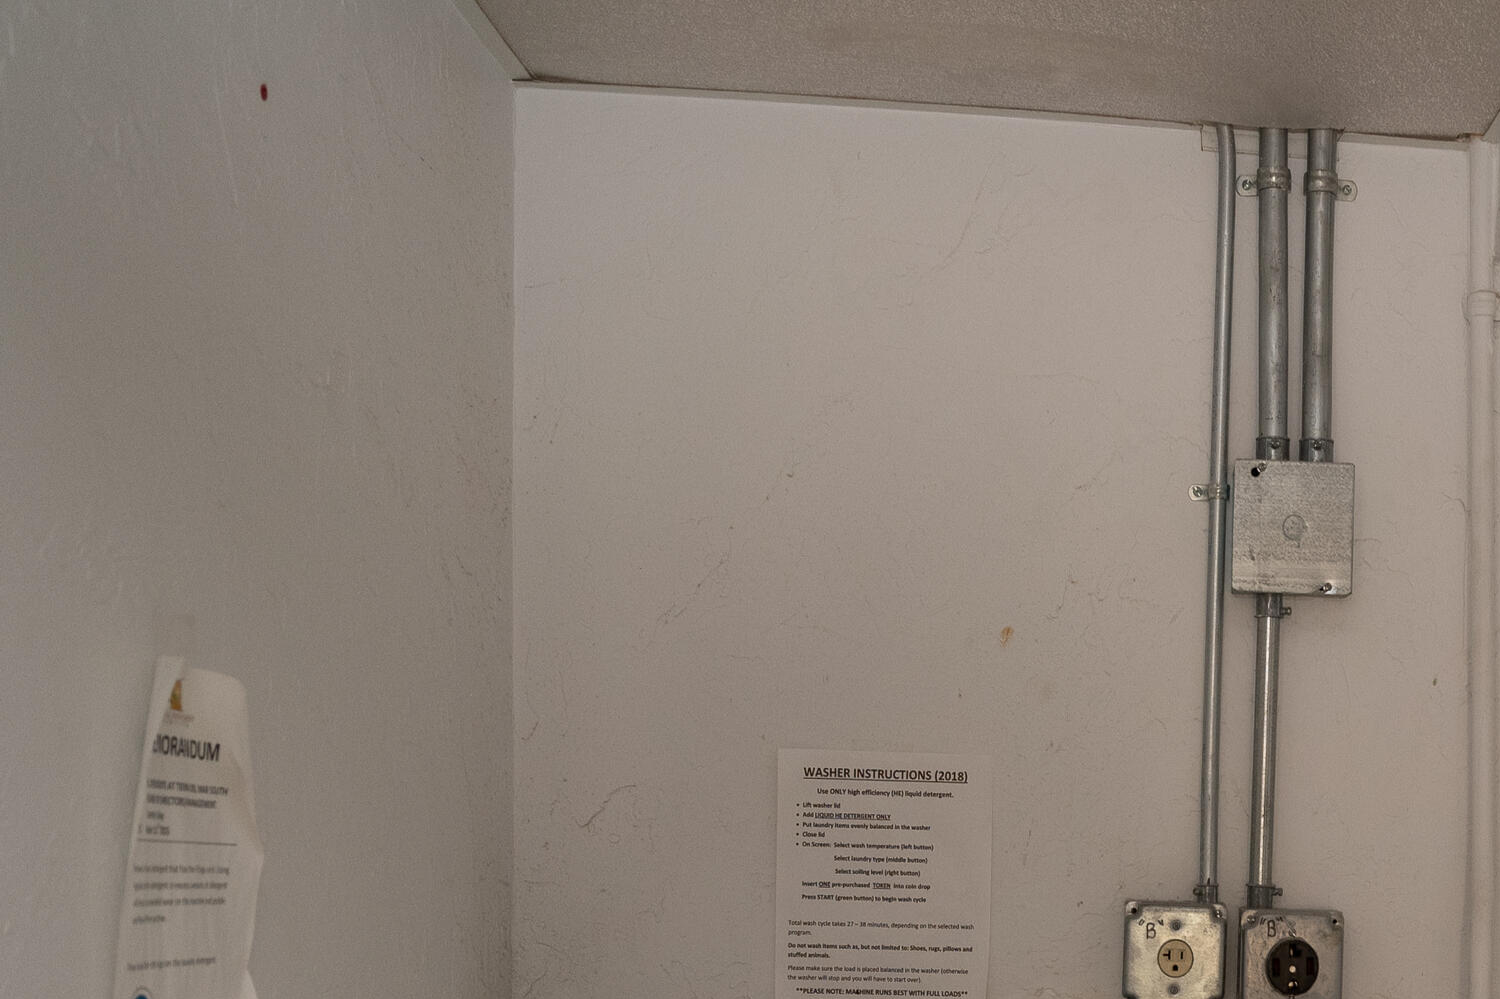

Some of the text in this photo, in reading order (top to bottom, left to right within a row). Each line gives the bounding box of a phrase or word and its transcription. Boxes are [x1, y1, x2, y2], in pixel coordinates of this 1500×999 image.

[803, 766, 967, 783] WASHER INSTRUCTIONS (2018)
